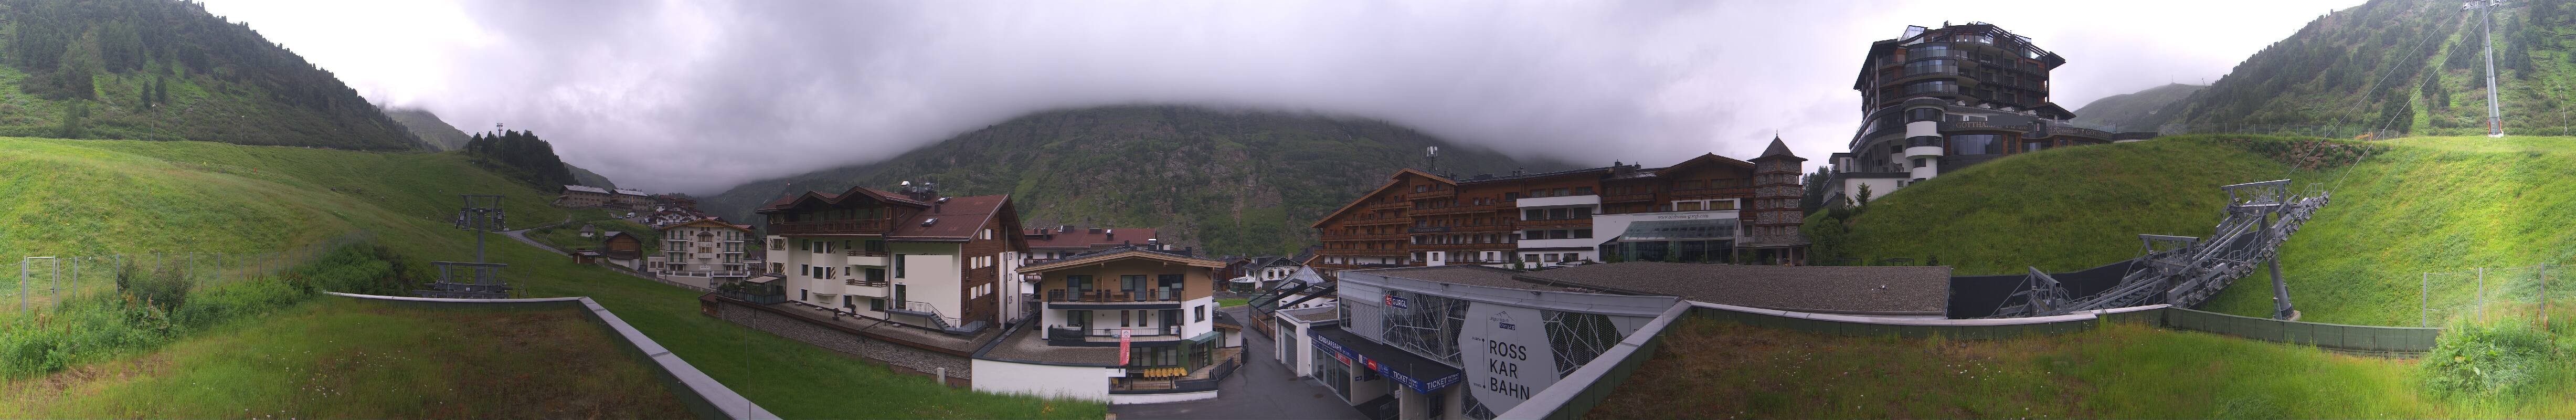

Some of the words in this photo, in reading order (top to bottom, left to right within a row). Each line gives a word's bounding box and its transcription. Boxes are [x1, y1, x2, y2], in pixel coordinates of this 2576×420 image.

[1392, 298, 1407, 308] GURGL
[1318, 334, 1342, 352] ROSSKARBAHN
[1490, 340, 1526, 361] ROSS
[1393, 371, 1408, 383] TICKET
[1490, 358, 1518, 379] KAR
[1427, 376, 1447, 390] TICKET
[1490, 376, 1530, 400] BAHN
